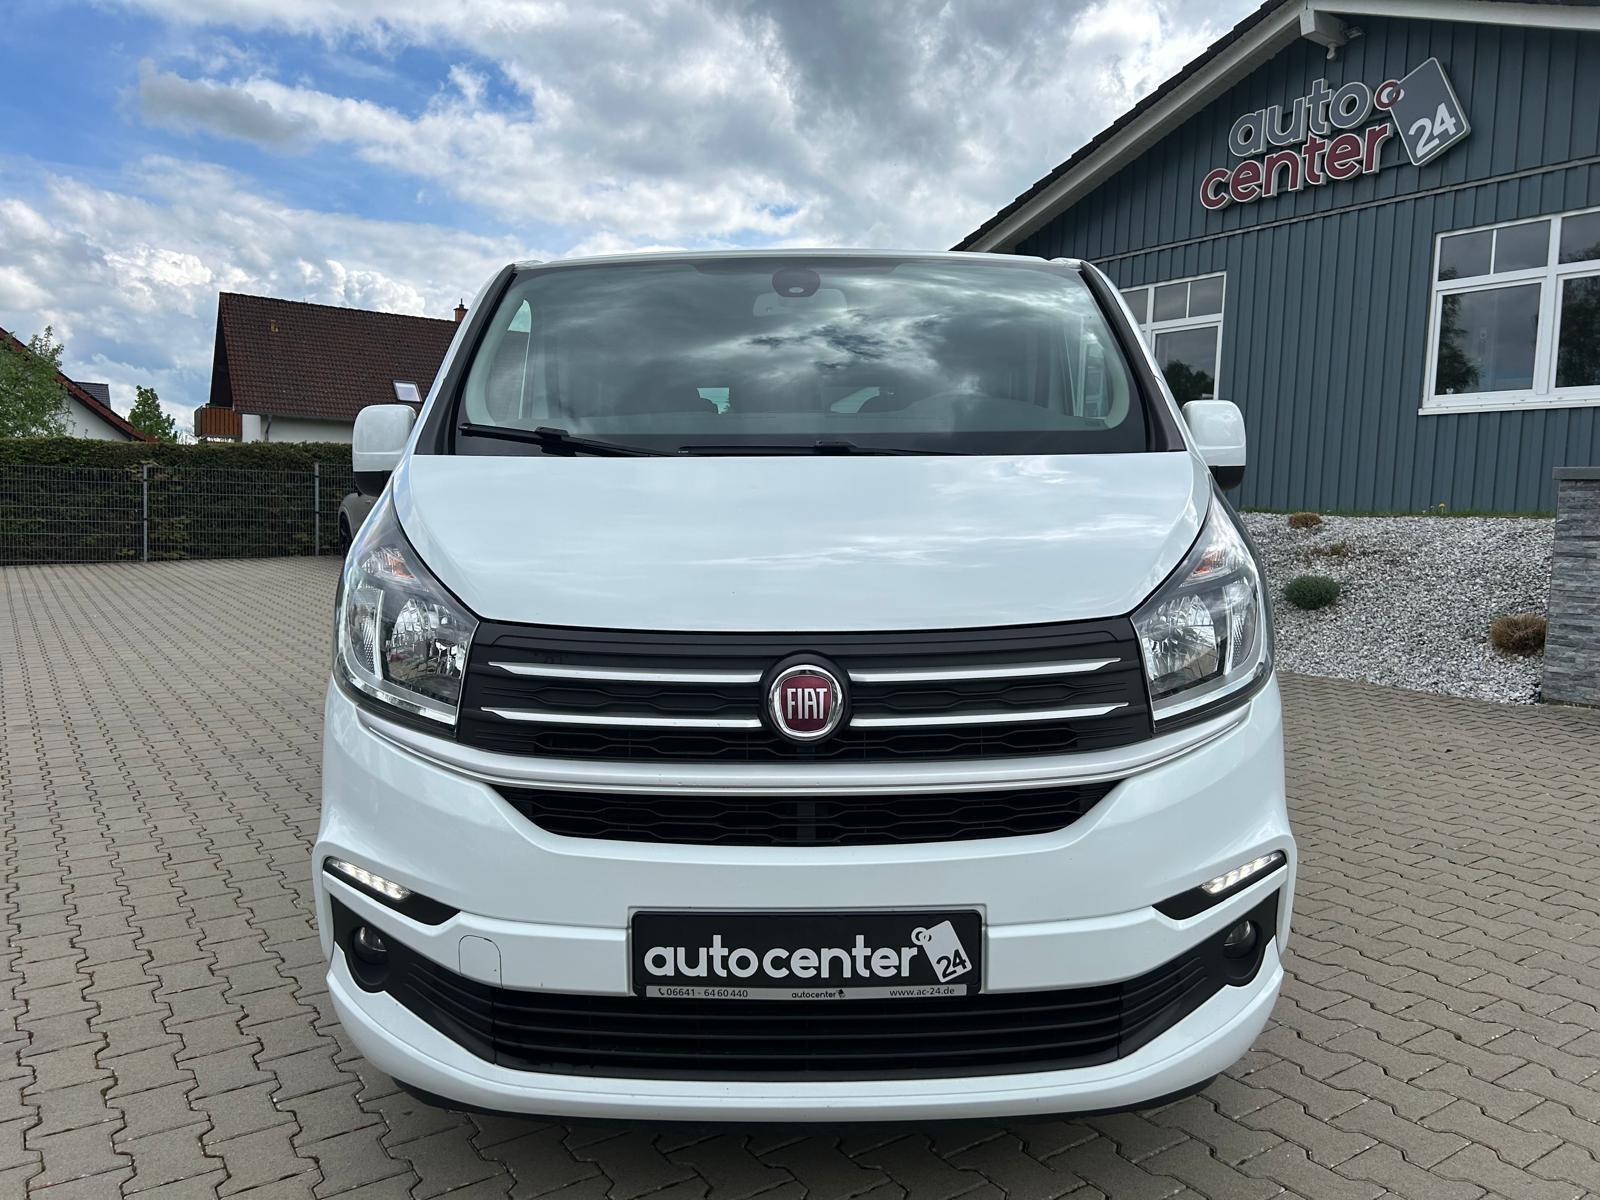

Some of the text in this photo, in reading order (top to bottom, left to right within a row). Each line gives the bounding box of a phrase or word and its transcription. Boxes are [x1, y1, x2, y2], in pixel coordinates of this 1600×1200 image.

[1228, 78, 1374, 157] auto
[1408, 102, 1457, 158] 24
[1200, 122, 1394, 210] center
[786, 687, 828, 720] FIAT
[935, 948, 968, 978] 24
[666, 987, 695, 996] 06641
[791, 990, 837, 999] autocenter
[889, 987, 955, 997] www.ac-24.de
